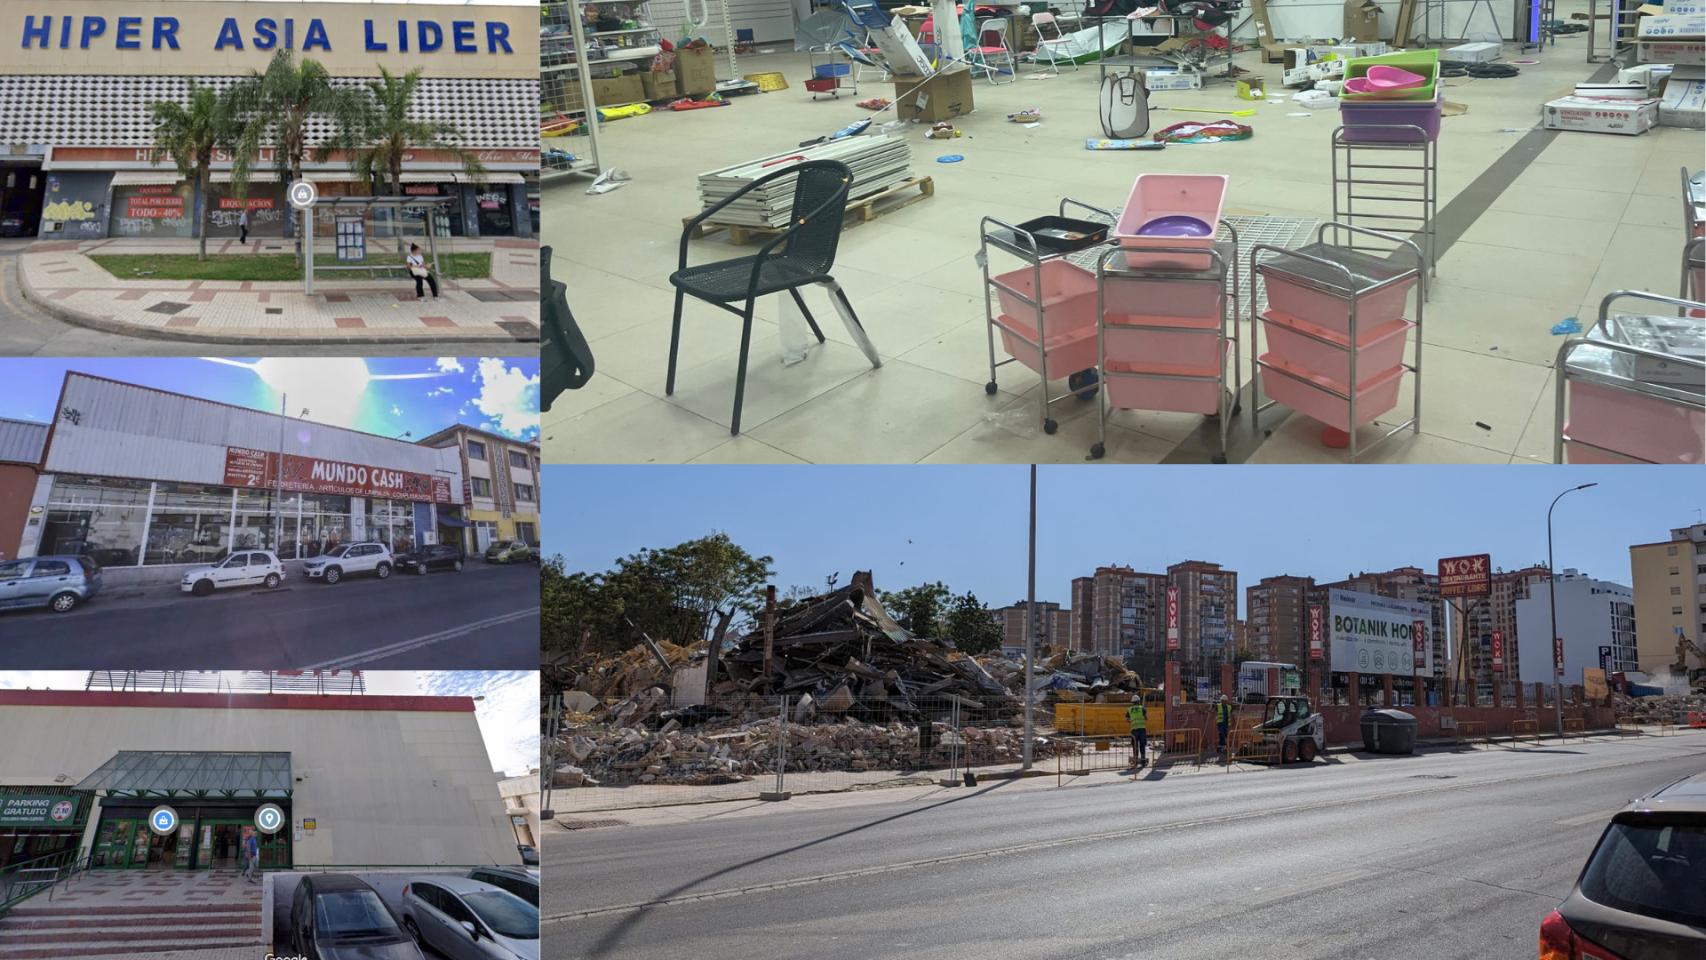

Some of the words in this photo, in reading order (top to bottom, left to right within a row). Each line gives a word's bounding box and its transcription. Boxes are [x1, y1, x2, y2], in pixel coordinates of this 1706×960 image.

[21, 15, 181, 50] HIPER
[214, 18, 332, 51] ASIA
[364, 19, 514, 54] LIDER
[136, 148, 178, 161] HIPE
[131, 207, 157, 217] TODO
[311, 461, 367, 485] MUNDO
[371, 468, 404, 489] CASH
[1443, 557, 1486, 576] WOK
[1167, 590, 1179, 629] WOK
[1310, 608, 1321, 641] WOK
[1335, 615, 1388, 637] BOTANIK
[1391, 622, 1430, 644] HOS
